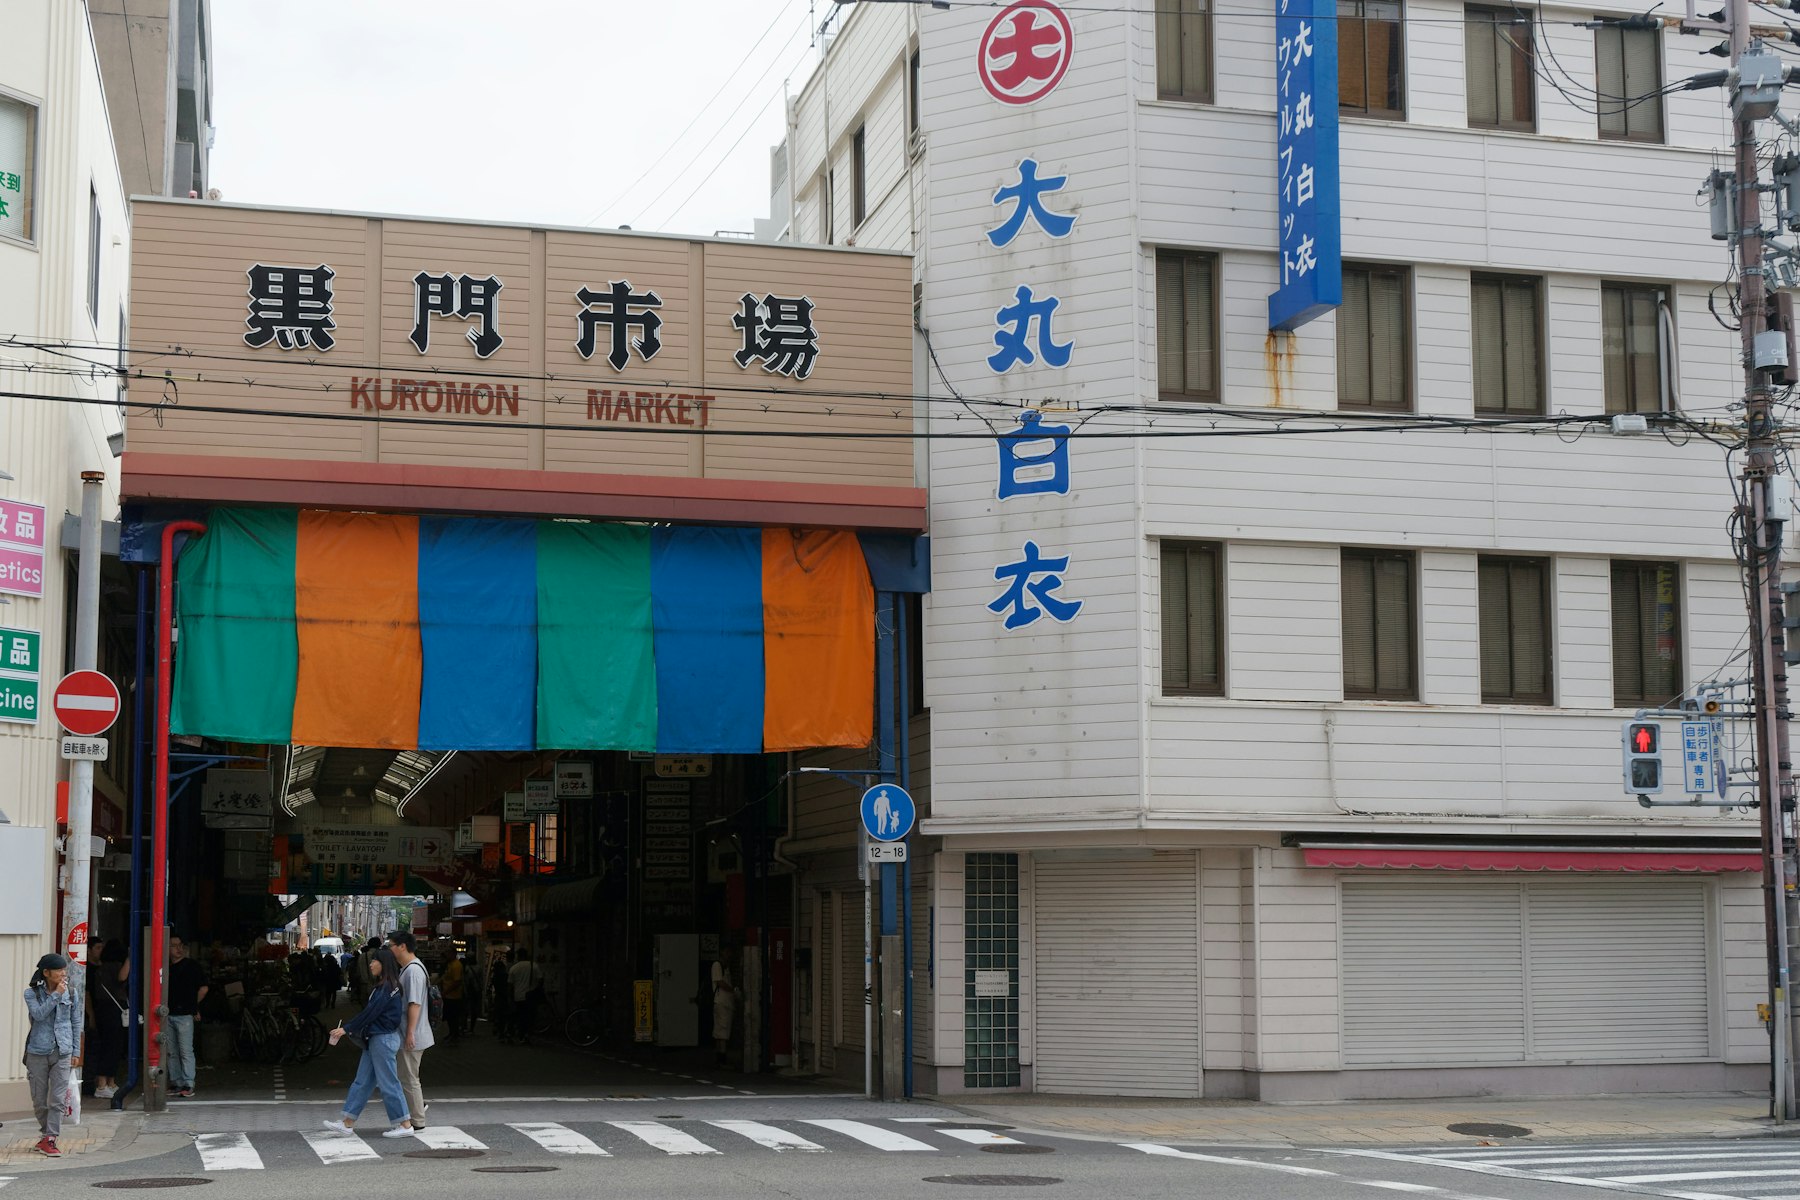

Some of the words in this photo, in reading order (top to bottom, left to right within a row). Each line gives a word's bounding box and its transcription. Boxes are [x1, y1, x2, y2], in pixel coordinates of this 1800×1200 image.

[1293, 20, 1317, 278] 大丸白衣
[242, 262, 820, 381] 黒門市場
[351, 376, 519, 417] KUROMON
[587, 388, 715, 427] MARKET
[984, 156, 1084, 632] 大丸白衣
[63, 742, 106, 756] 自転車を除く
[1686, 726, 1697, 762] 自転車
[1697, 726, 1708, 762] 歩行者
[1694, 765, 1705, 789] 専用
[346, 845, 386, 853] LAVATORY
